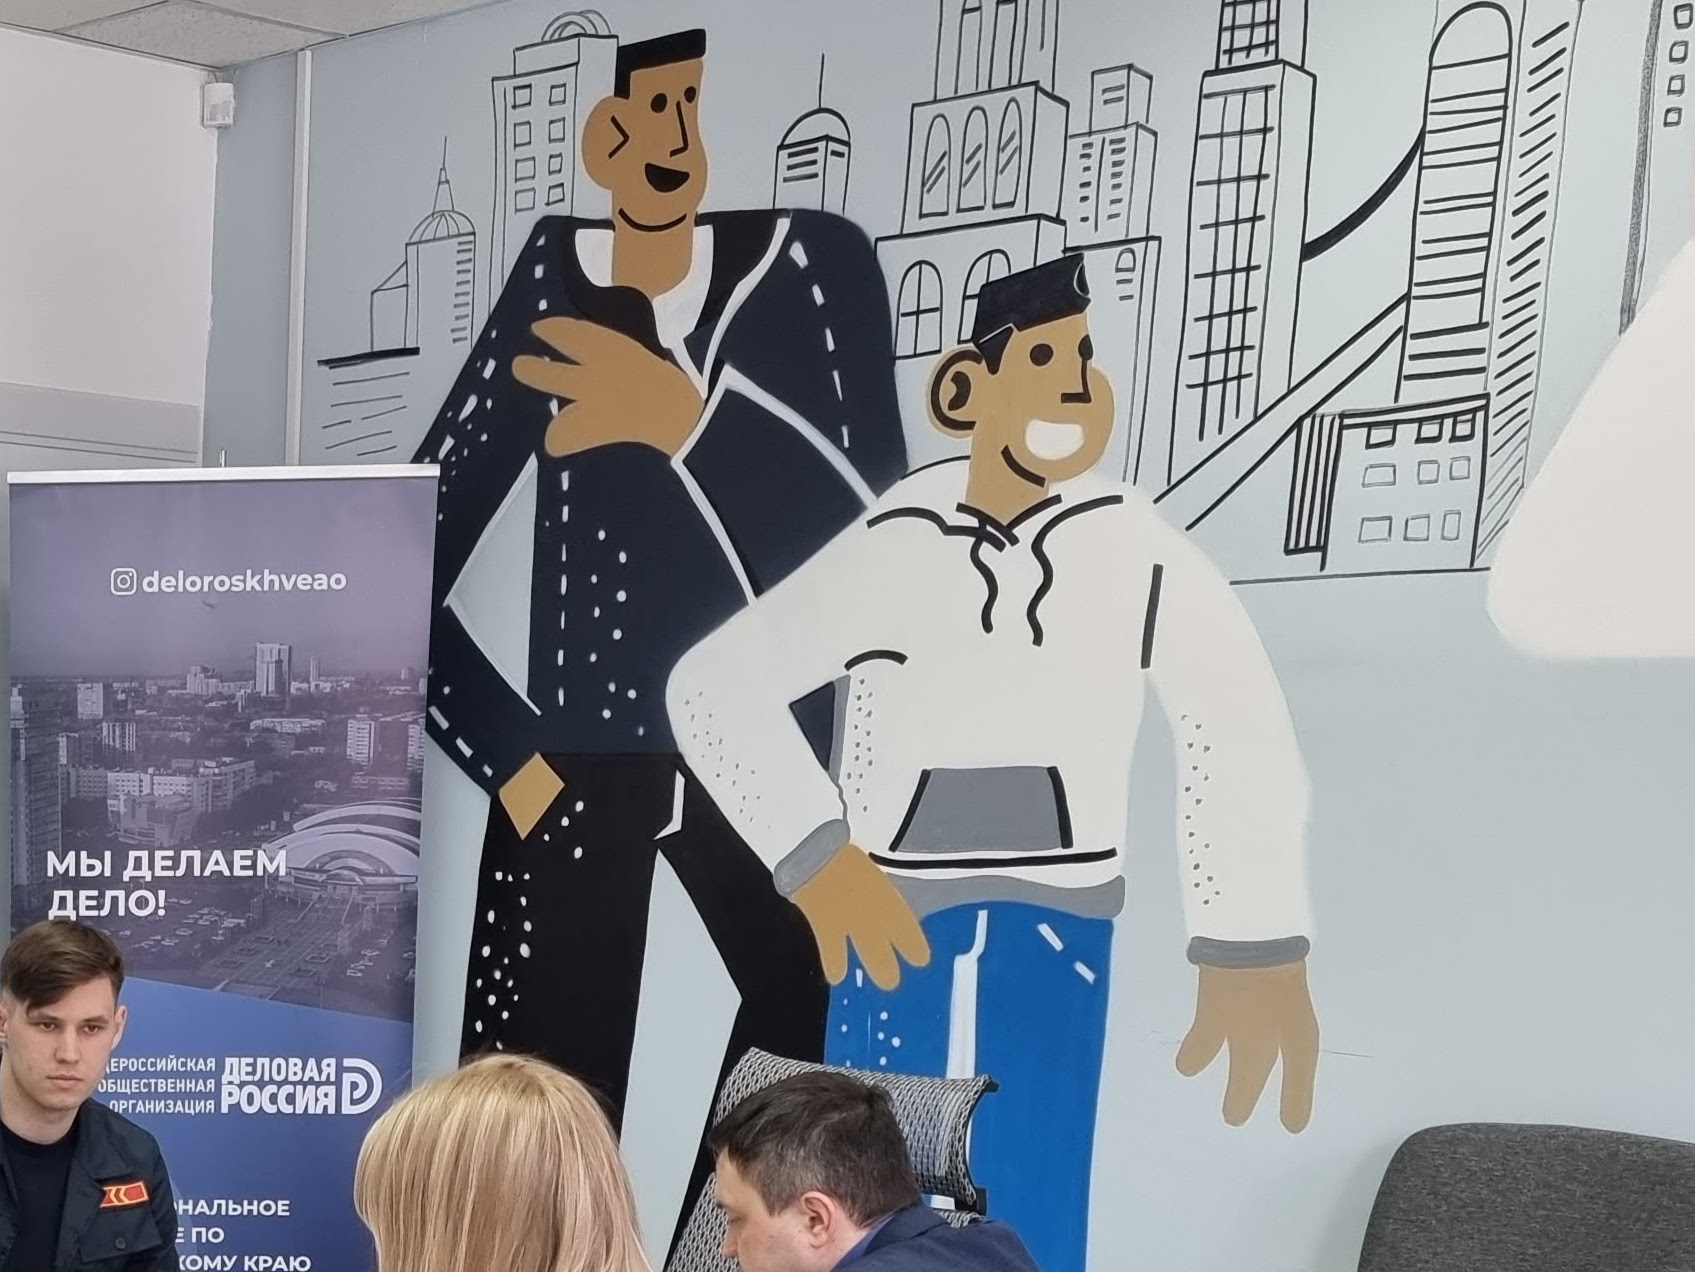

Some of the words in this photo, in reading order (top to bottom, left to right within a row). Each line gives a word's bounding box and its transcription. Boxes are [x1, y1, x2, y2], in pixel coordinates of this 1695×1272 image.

[142, 569, 347, 593] deloroskhveao
[47, 850, 112, 877] МЫ
[122, 850, 287, 882] ДЕЛАЕМ
[48, 889, 167, 922] ДЕЛО!
[105, 1054, 216, 1074] ЕРОССИЙСКАЯ
[221, 1057, 336, 1084] ДЕЛОВАЯ
[97, 1078, 216, 1095] ОБЩЕСТВЕННАЯ
[109, 1099, 215, 1116] ОРГАНИЗАЦИЯ
[221, 1085, 336, 1115] РОССИЯ
[174, 1199, 291, 1216] НАЛЬНОЕ
[191, 1226, 225, 1244] ПО
[243, 1255, 312, 1272] КРАЮ
